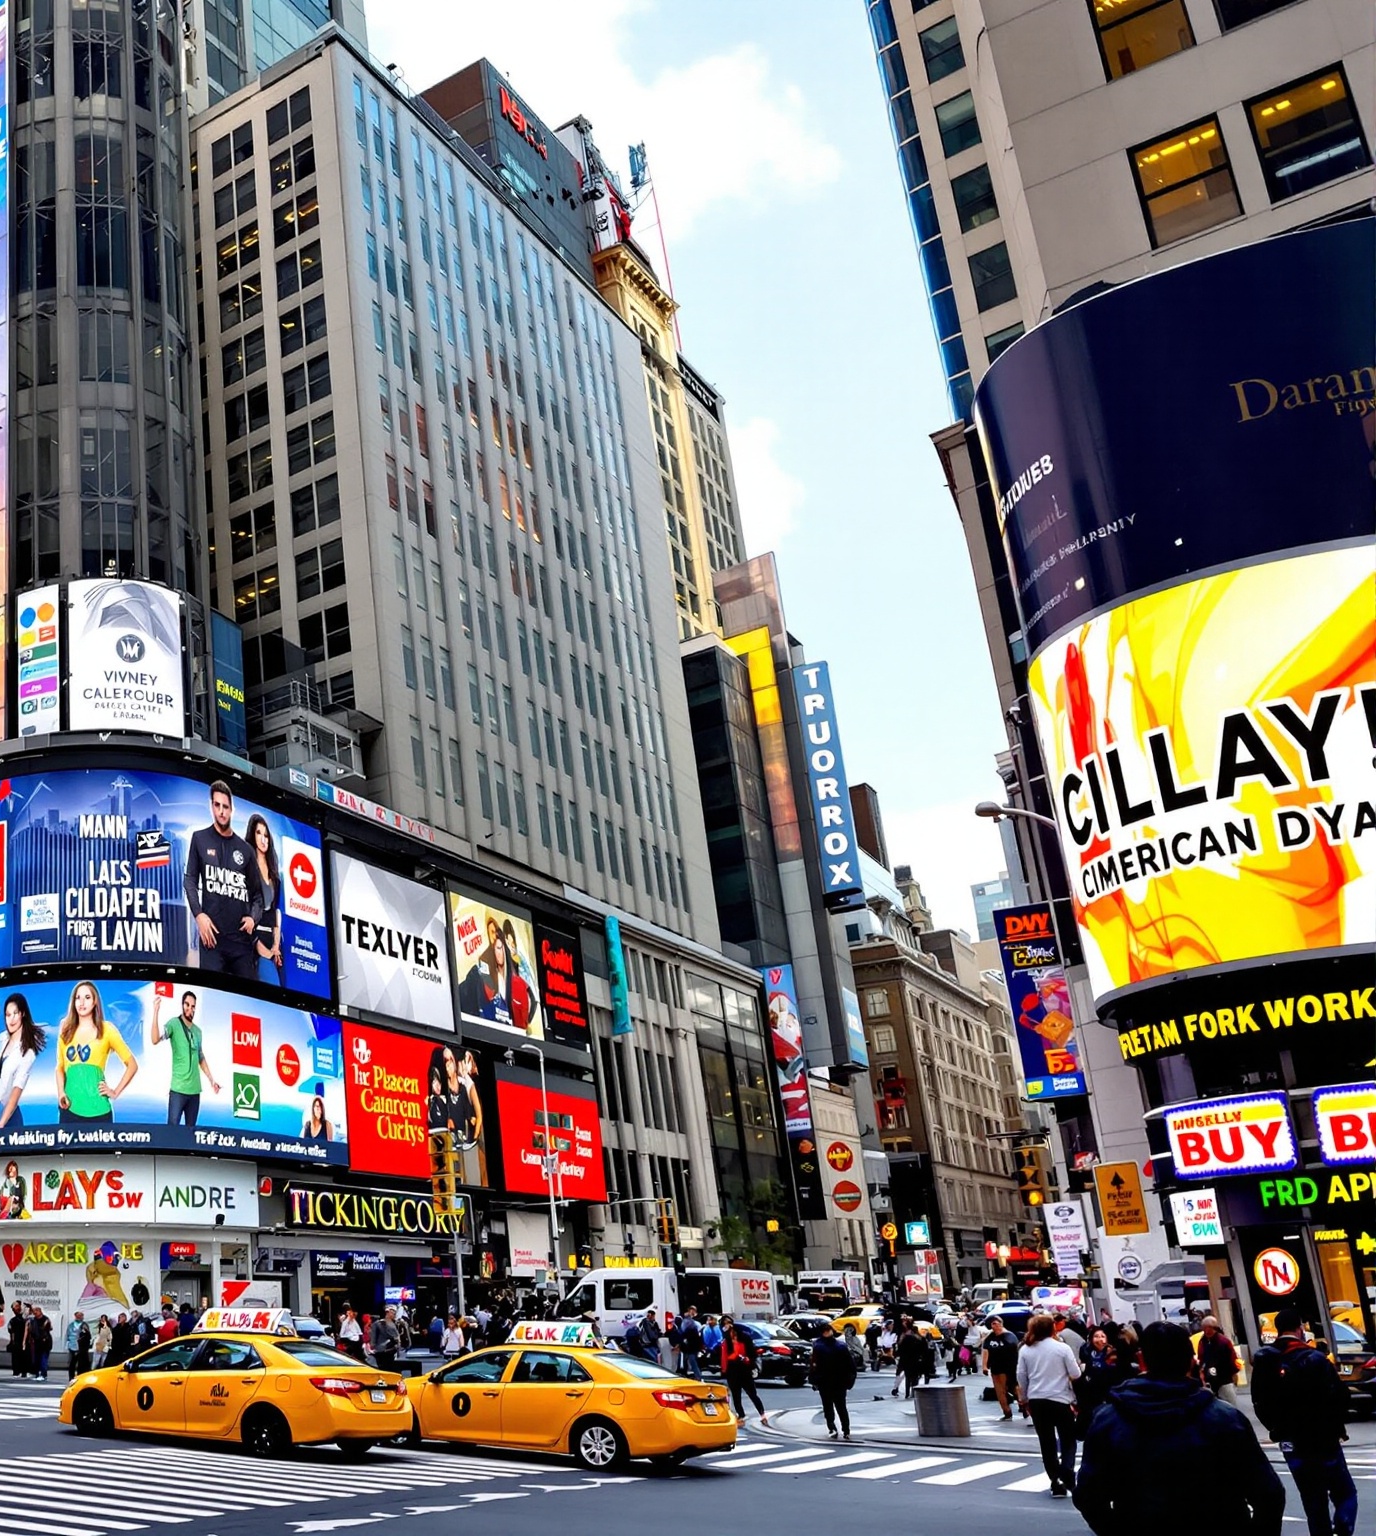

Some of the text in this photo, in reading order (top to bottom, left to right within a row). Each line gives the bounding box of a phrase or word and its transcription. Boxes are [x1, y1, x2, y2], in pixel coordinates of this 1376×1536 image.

[803, 667, 853, 885] TRUORROX
[79, 814, 128, 840] MANN
[342, 914, 439, 970] TEXLYER
[234, 1029, 260, 1048] LOW
[1184, 1003, 1260, 1041] FORK
[1177, 1121, 1282, 1167] BUY
[159, 1185, 236, 1209] ANDRE
[1260, 1177, 1319, 1207] FRD
